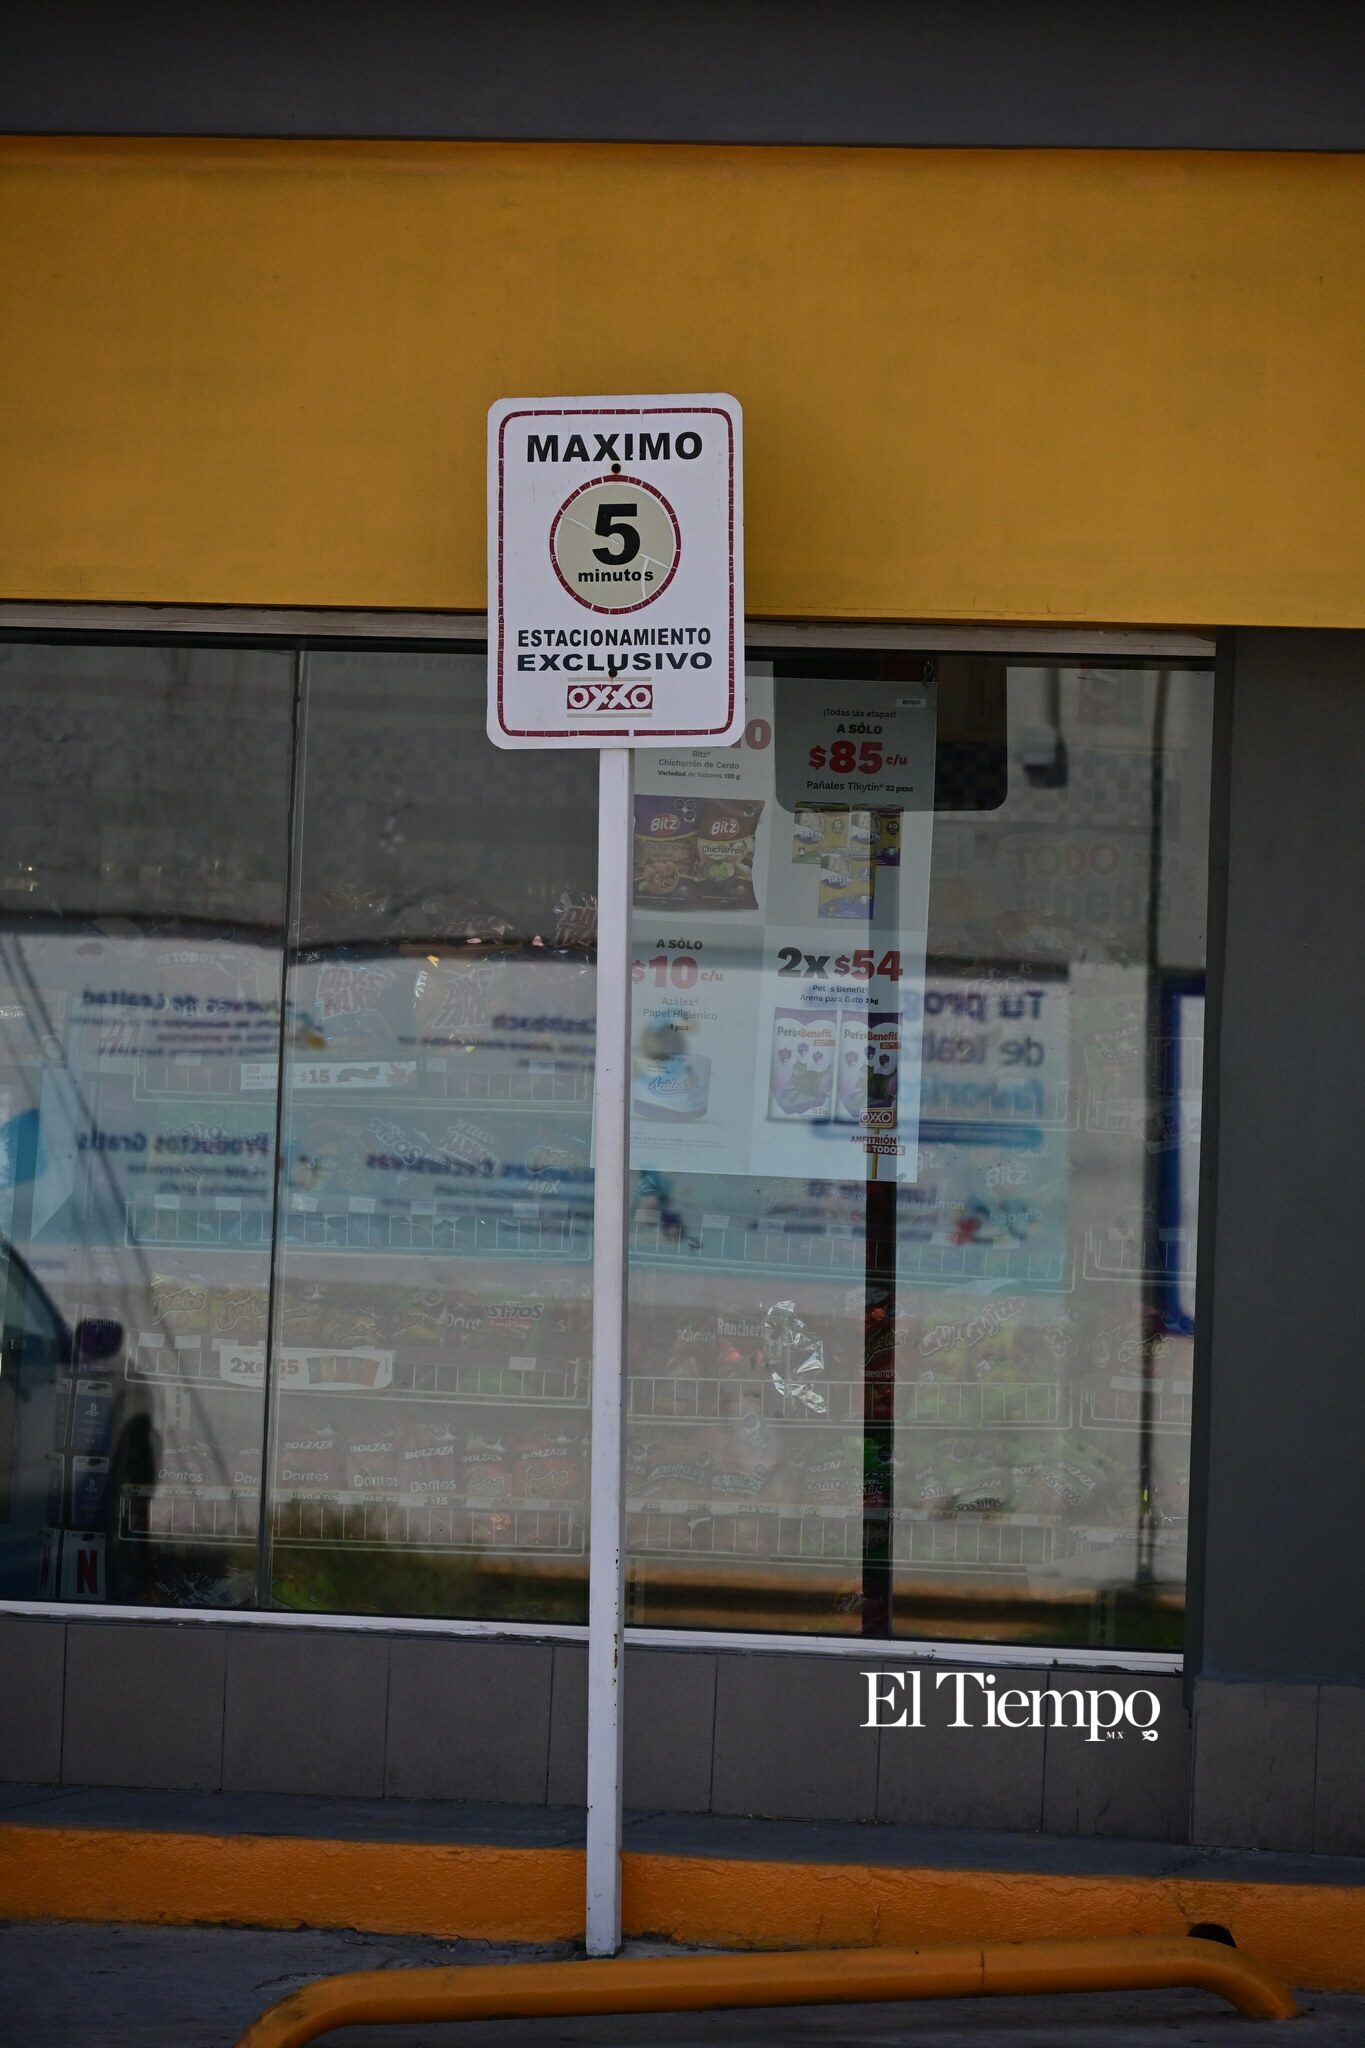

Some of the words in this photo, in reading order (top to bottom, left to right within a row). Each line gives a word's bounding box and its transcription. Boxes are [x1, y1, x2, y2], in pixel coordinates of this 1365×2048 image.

[526, 431, 703, 463] MAXIMO
[592, 503, 641, 566] 5
[578, 568, 654, 583] minutos
[517, 627, 711, 648] ESTACIONAMIENTO
[517, 651, 713, 672] EXCLUSIVO
[568, 685, 652, 709] OXXO
[852, 709, 865, 718] las
[866, 710, 896, 719] etapas!
[836, 724, 846, 733] A
[848, 722, 883, 735] SÓLO
[658, 758, 702, 768] Chicharrón
[716, 761, 740, 770] Cerdo
[808, 740, 883, 775] $85
[885, 754, 908, 766] c/u
[807, 781, 845, 791] Pañales
[650, 818, 677, 831] Bitz
[711, 821, 737, 835] Bitz
[656, 938, 666, 949] A
[668, 937, 703, 950] SÓLO
[632, 955, 699, 989] $10
[700, 970, 724, 981] c/u
[834, 949, 904, 982] $54
[800, 994, 823, 1002] Arena
[824, 996, 842, 1004] para
[643, 1008, 670, 1018] Papel
[672, 1009, 718, 1020] Higiénico
[861, 1111, 891, 1123] OXXO
[872, 1145, 903, 1155] TODOS
